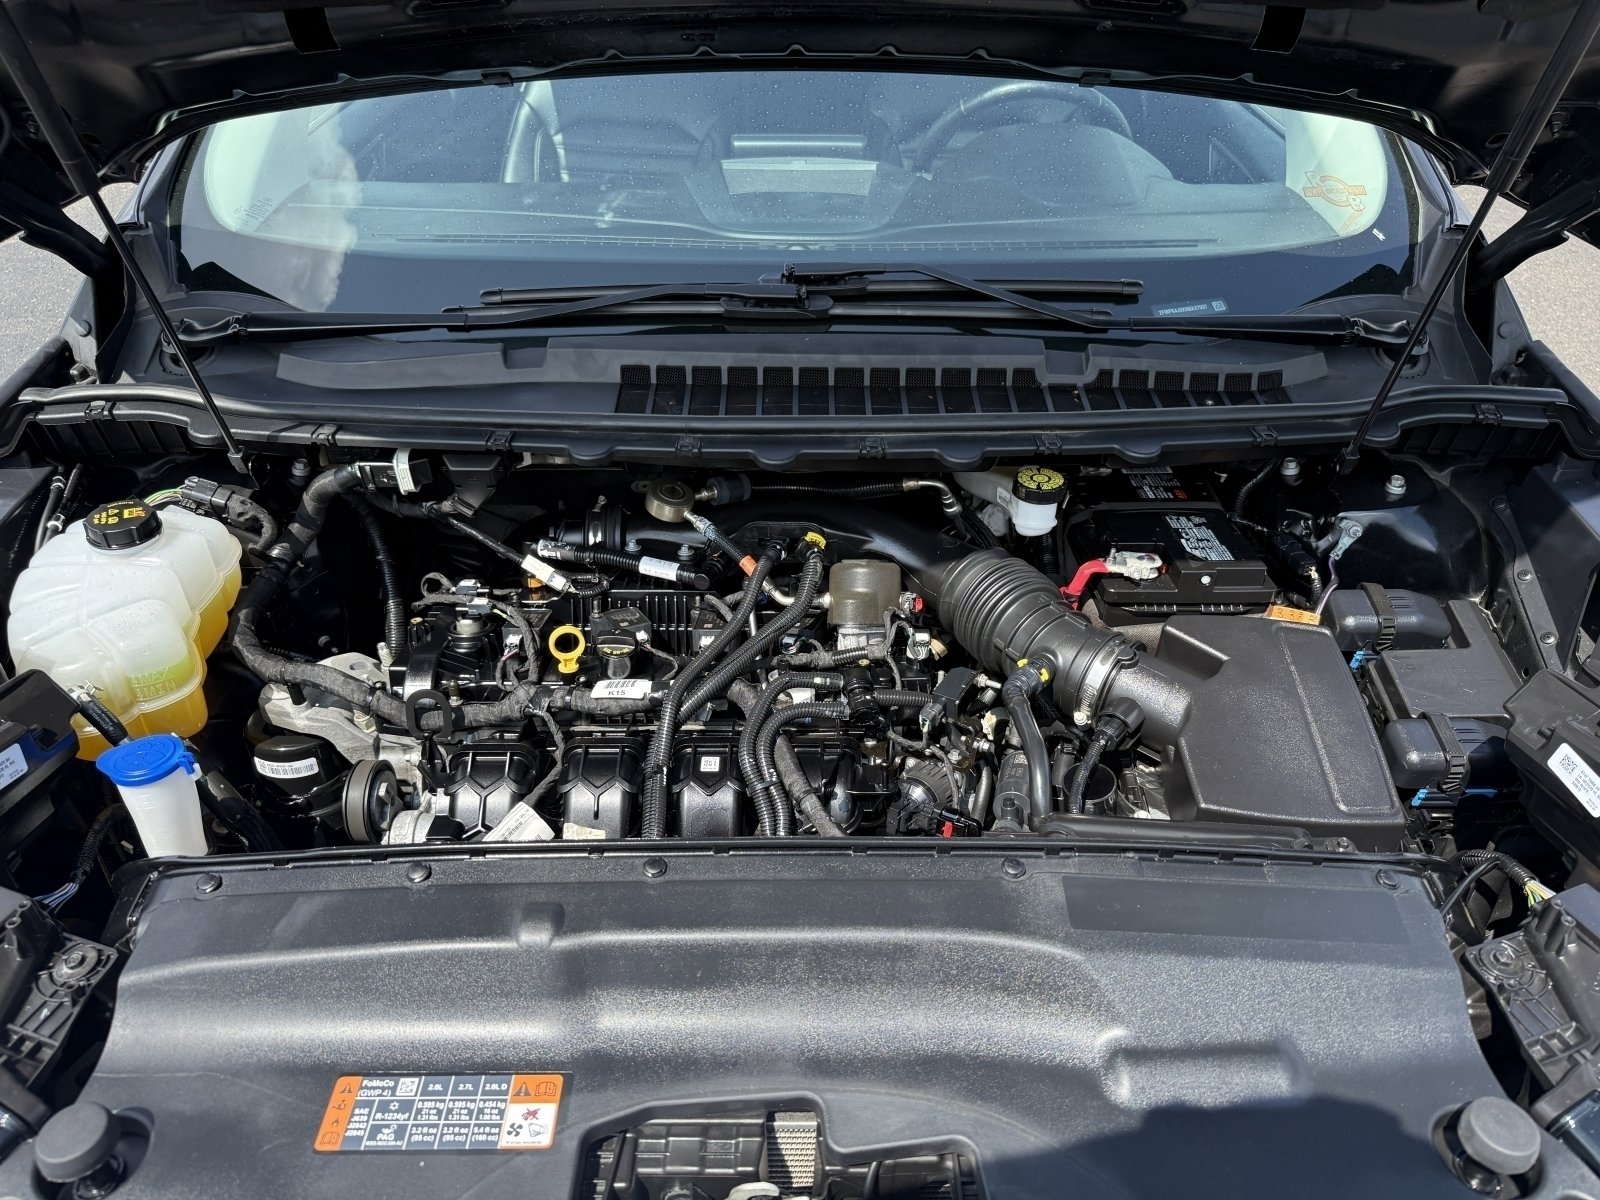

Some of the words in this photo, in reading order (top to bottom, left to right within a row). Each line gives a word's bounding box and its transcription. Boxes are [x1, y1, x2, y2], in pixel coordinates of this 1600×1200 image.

[143, 680, 178, 698] MIN
[362, 1079, 395, 1087] FoMoCo
[427, 1083, 443, 1091] 2.0L
[458, 1083, 474, 1091] 2.7L
[357, 1089, 381, 1097] (GWP
[382, 1089, 392, 1097] 4)
[436, 1101, 445, 1110] kg
[466, 1101, 476, 1110] kg
[497, 1101, 506, 1110] kg
[374, 1112, 410, 1121] R-1234yf
[376, 1133, 395, 1141] PAG
